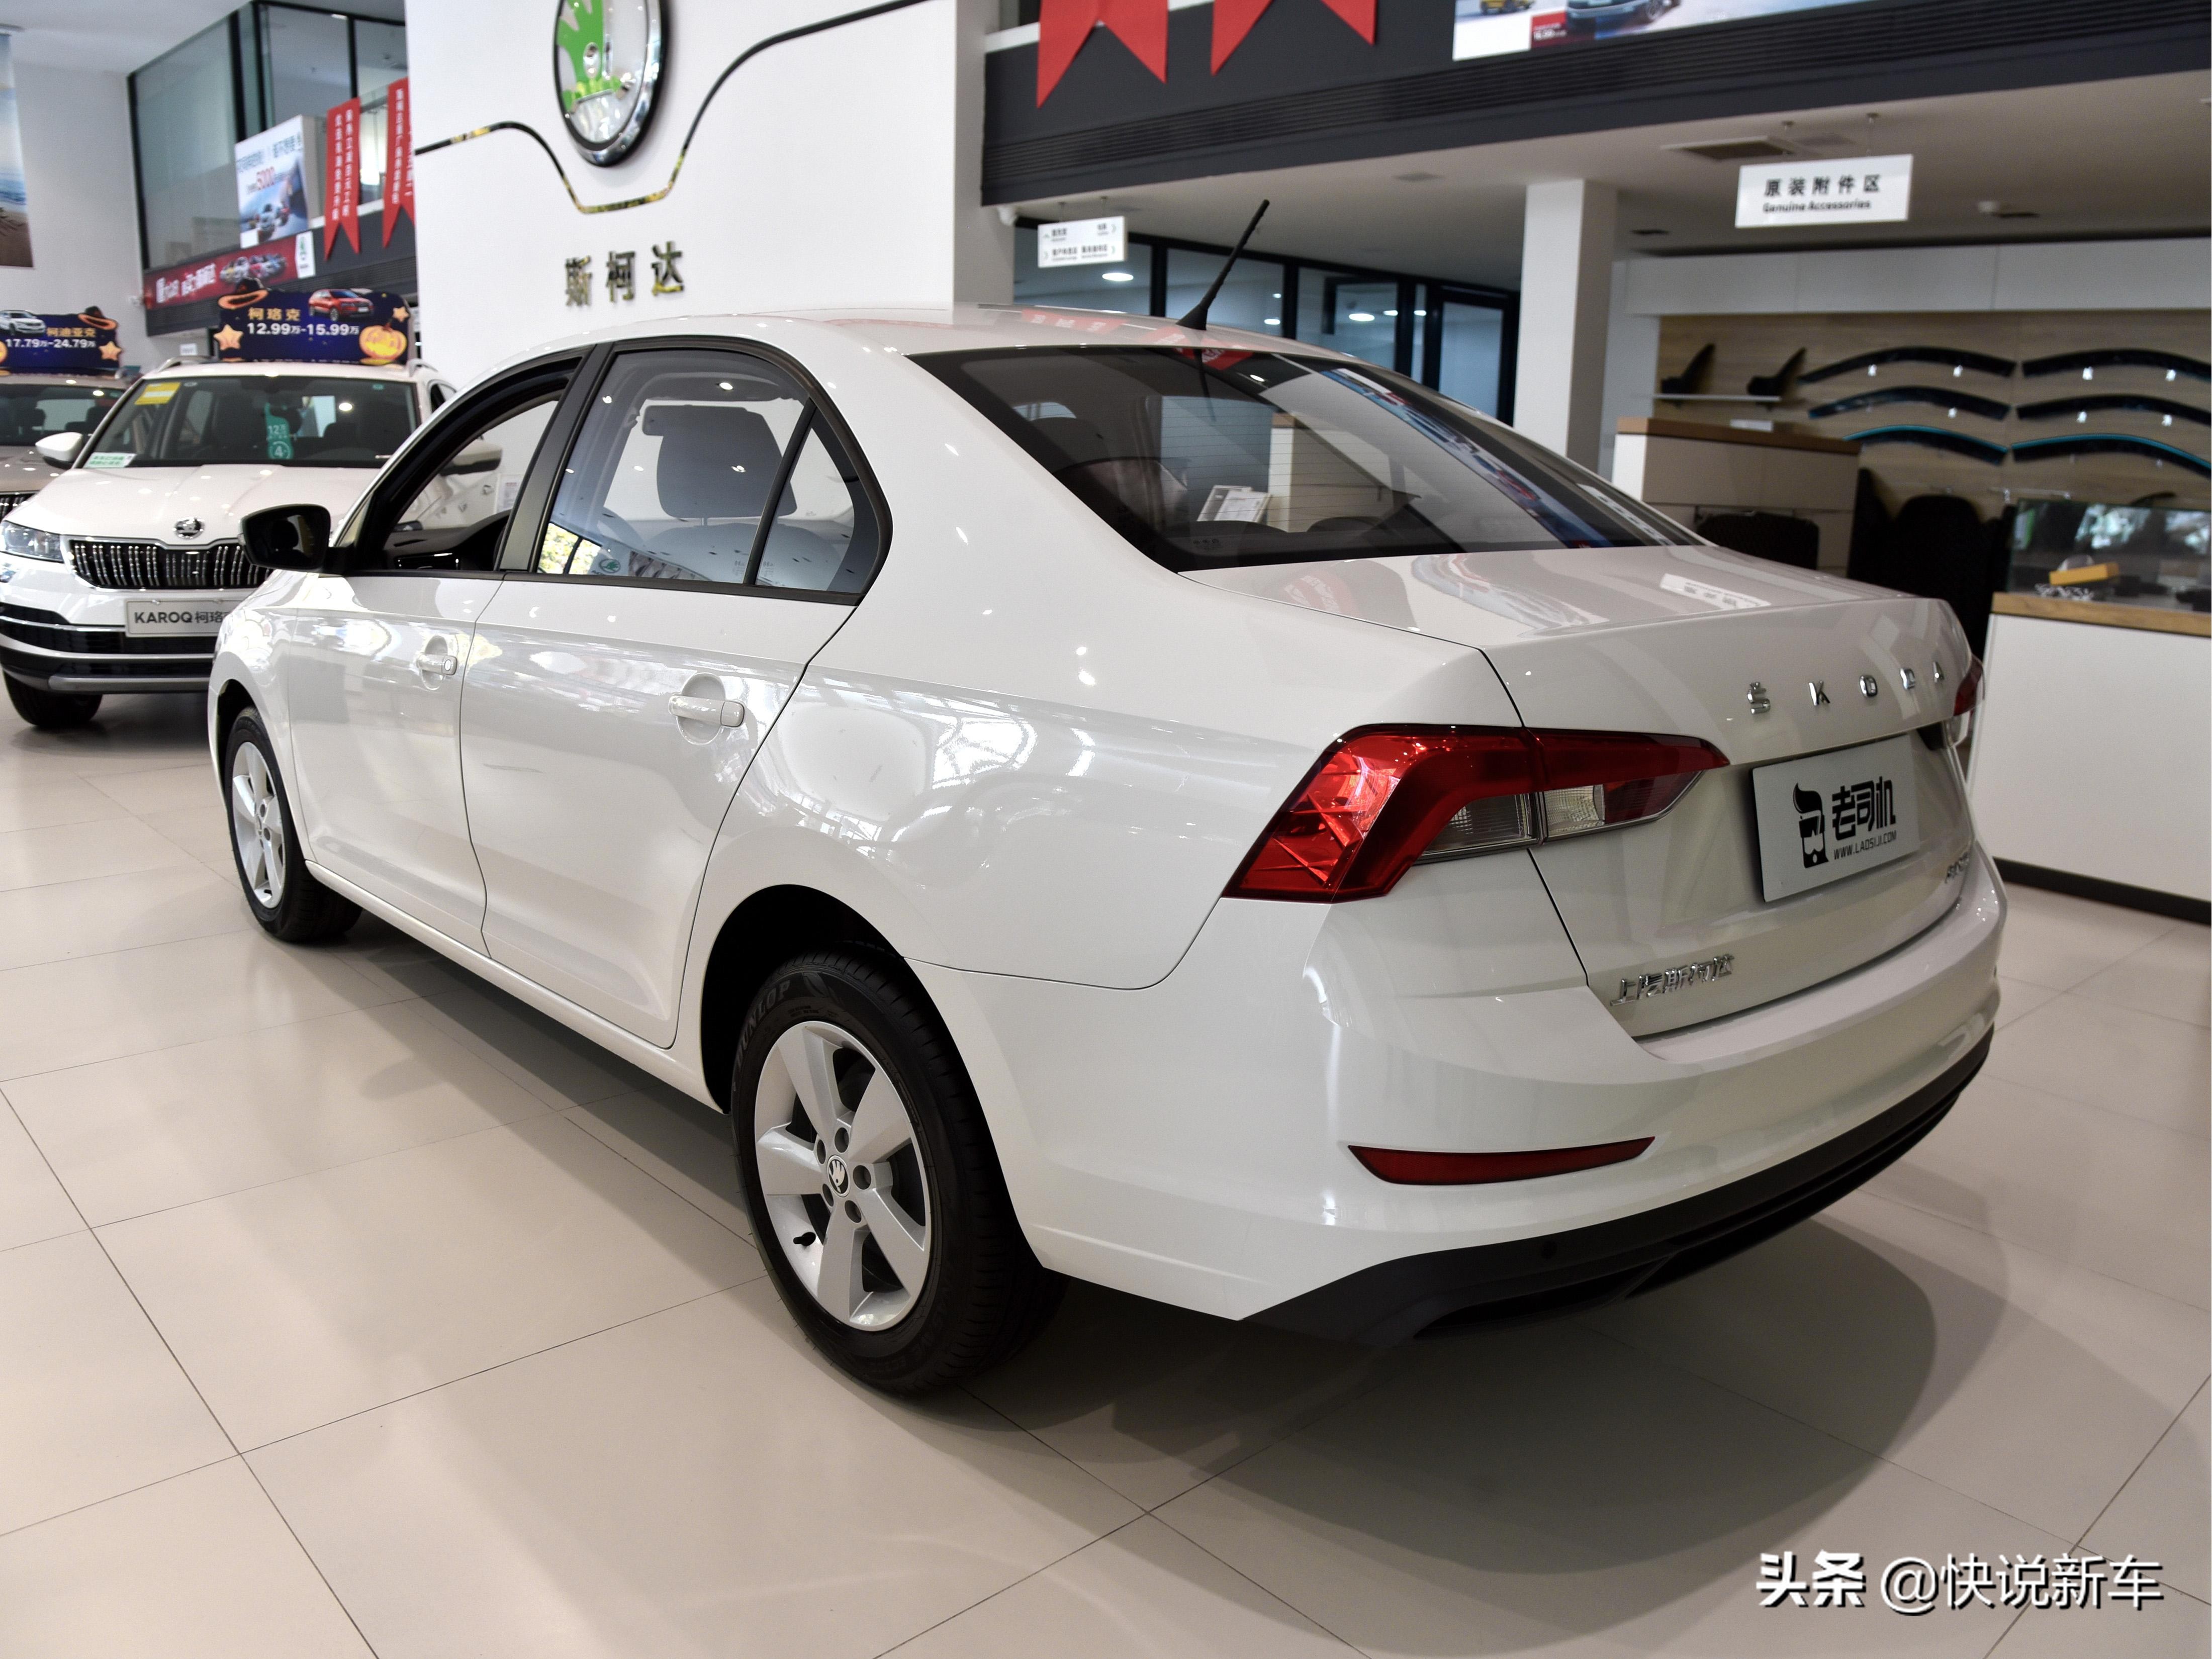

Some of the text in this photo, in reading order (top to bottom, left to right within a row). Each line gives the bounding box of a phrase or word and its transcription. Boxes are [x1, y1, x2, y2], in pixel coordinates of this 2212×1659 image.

[1764, 174, 1881, 197] 原装附件区
[1763, 198, 1871, 213] Genuine Accessories
[565, 240, 684, 307] 斯柯达
[248, 307, 301, 321] 柯珞克
[134, 611, 193, 623] KAROQ
[1831, 775, 1896, 841] 老司机
[1833, 831, 1897, 860] WWW.LAOSIJI.COM
